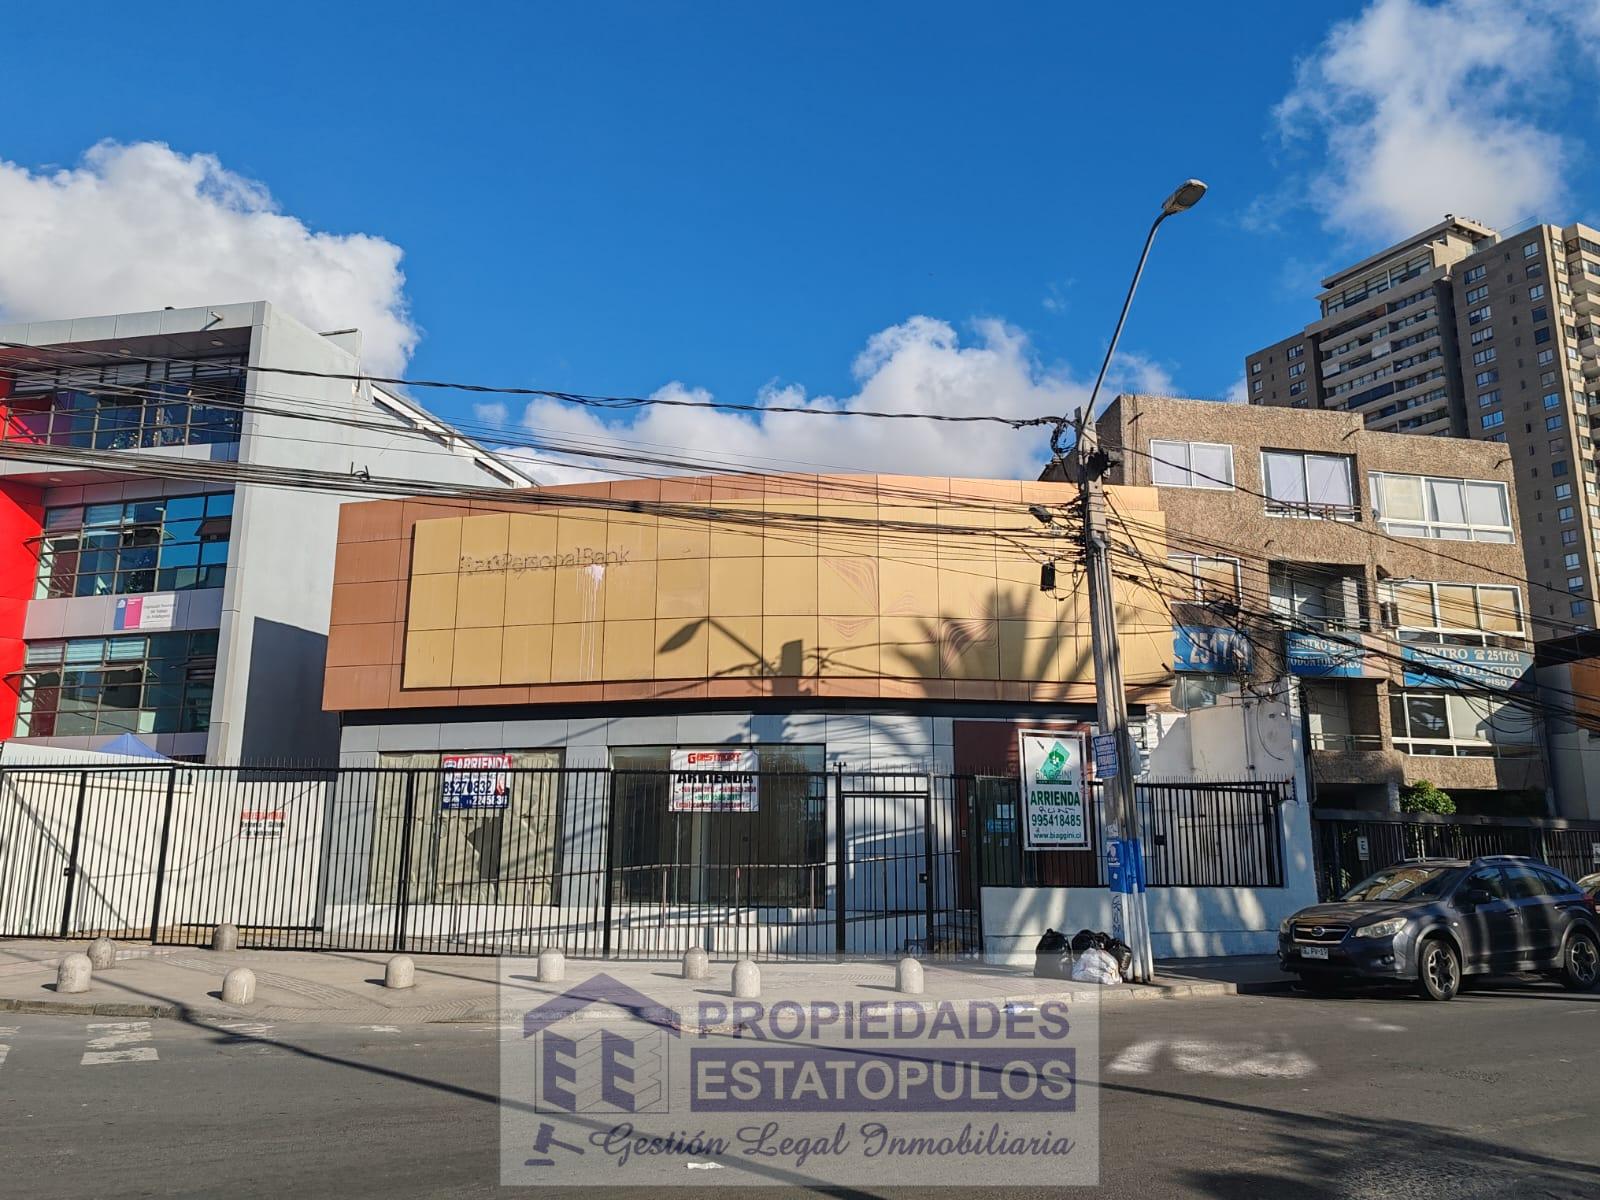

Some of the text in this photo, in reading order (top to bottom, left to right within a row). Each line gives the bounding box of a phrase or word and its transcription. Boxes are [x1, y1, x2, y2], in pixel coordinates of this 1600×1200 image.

[1290, 638, 1328, 650] CENTRO
[1412, 646, 1520, 662] CENTRO 251731
[1411, 660, 1522, 679] ONTOLOGICO
[457, 757, 509, 769] ARRIENDA
[1030, 791, 1081, 807] ARRIENDA
[1031, 814, 1081, 828] 995418485
